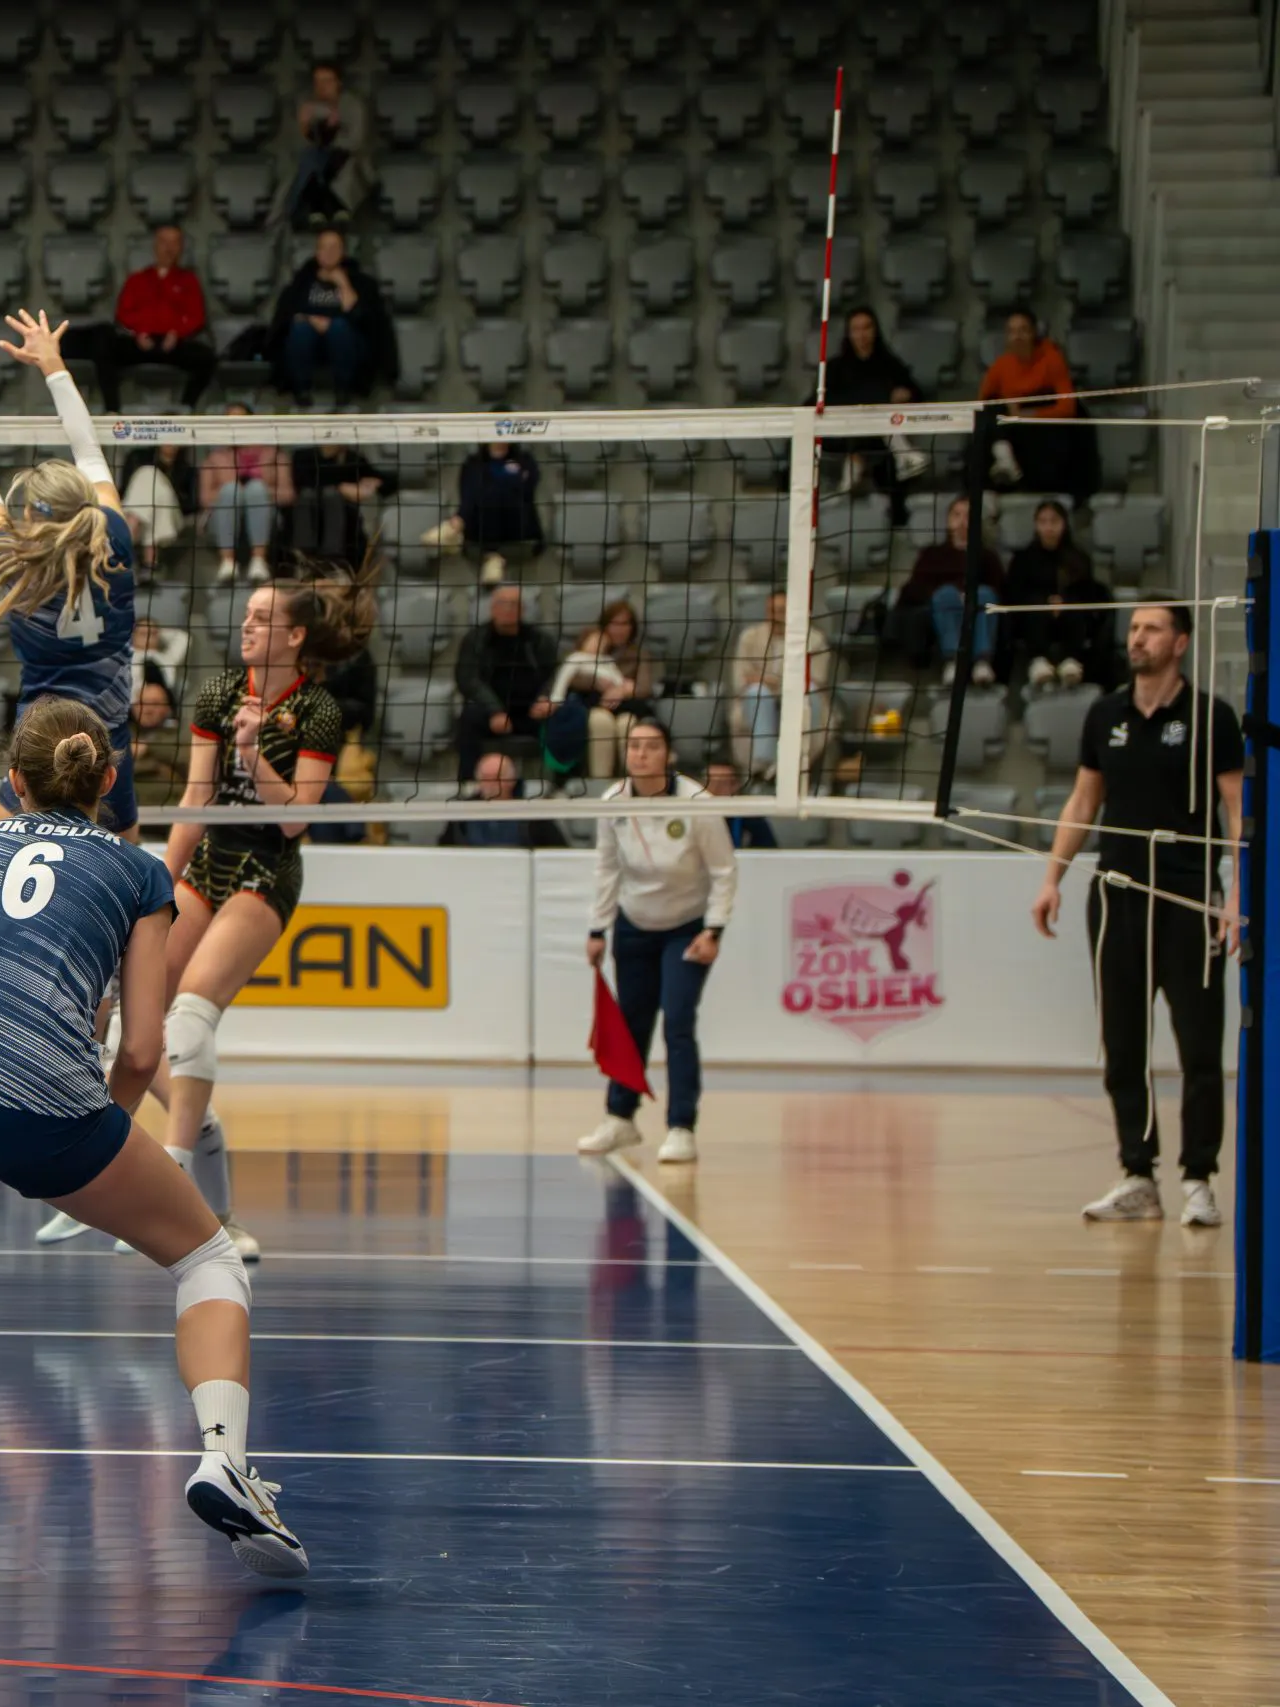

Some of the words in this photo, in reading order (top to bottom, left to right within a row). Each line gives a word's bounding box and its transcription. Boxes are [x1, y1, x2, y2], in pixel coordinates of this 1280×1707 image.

[56, 574, 105, 648] 4
[1, 841, 64, 920] 6
[781, 973, 945, 1013] OSIJEK
